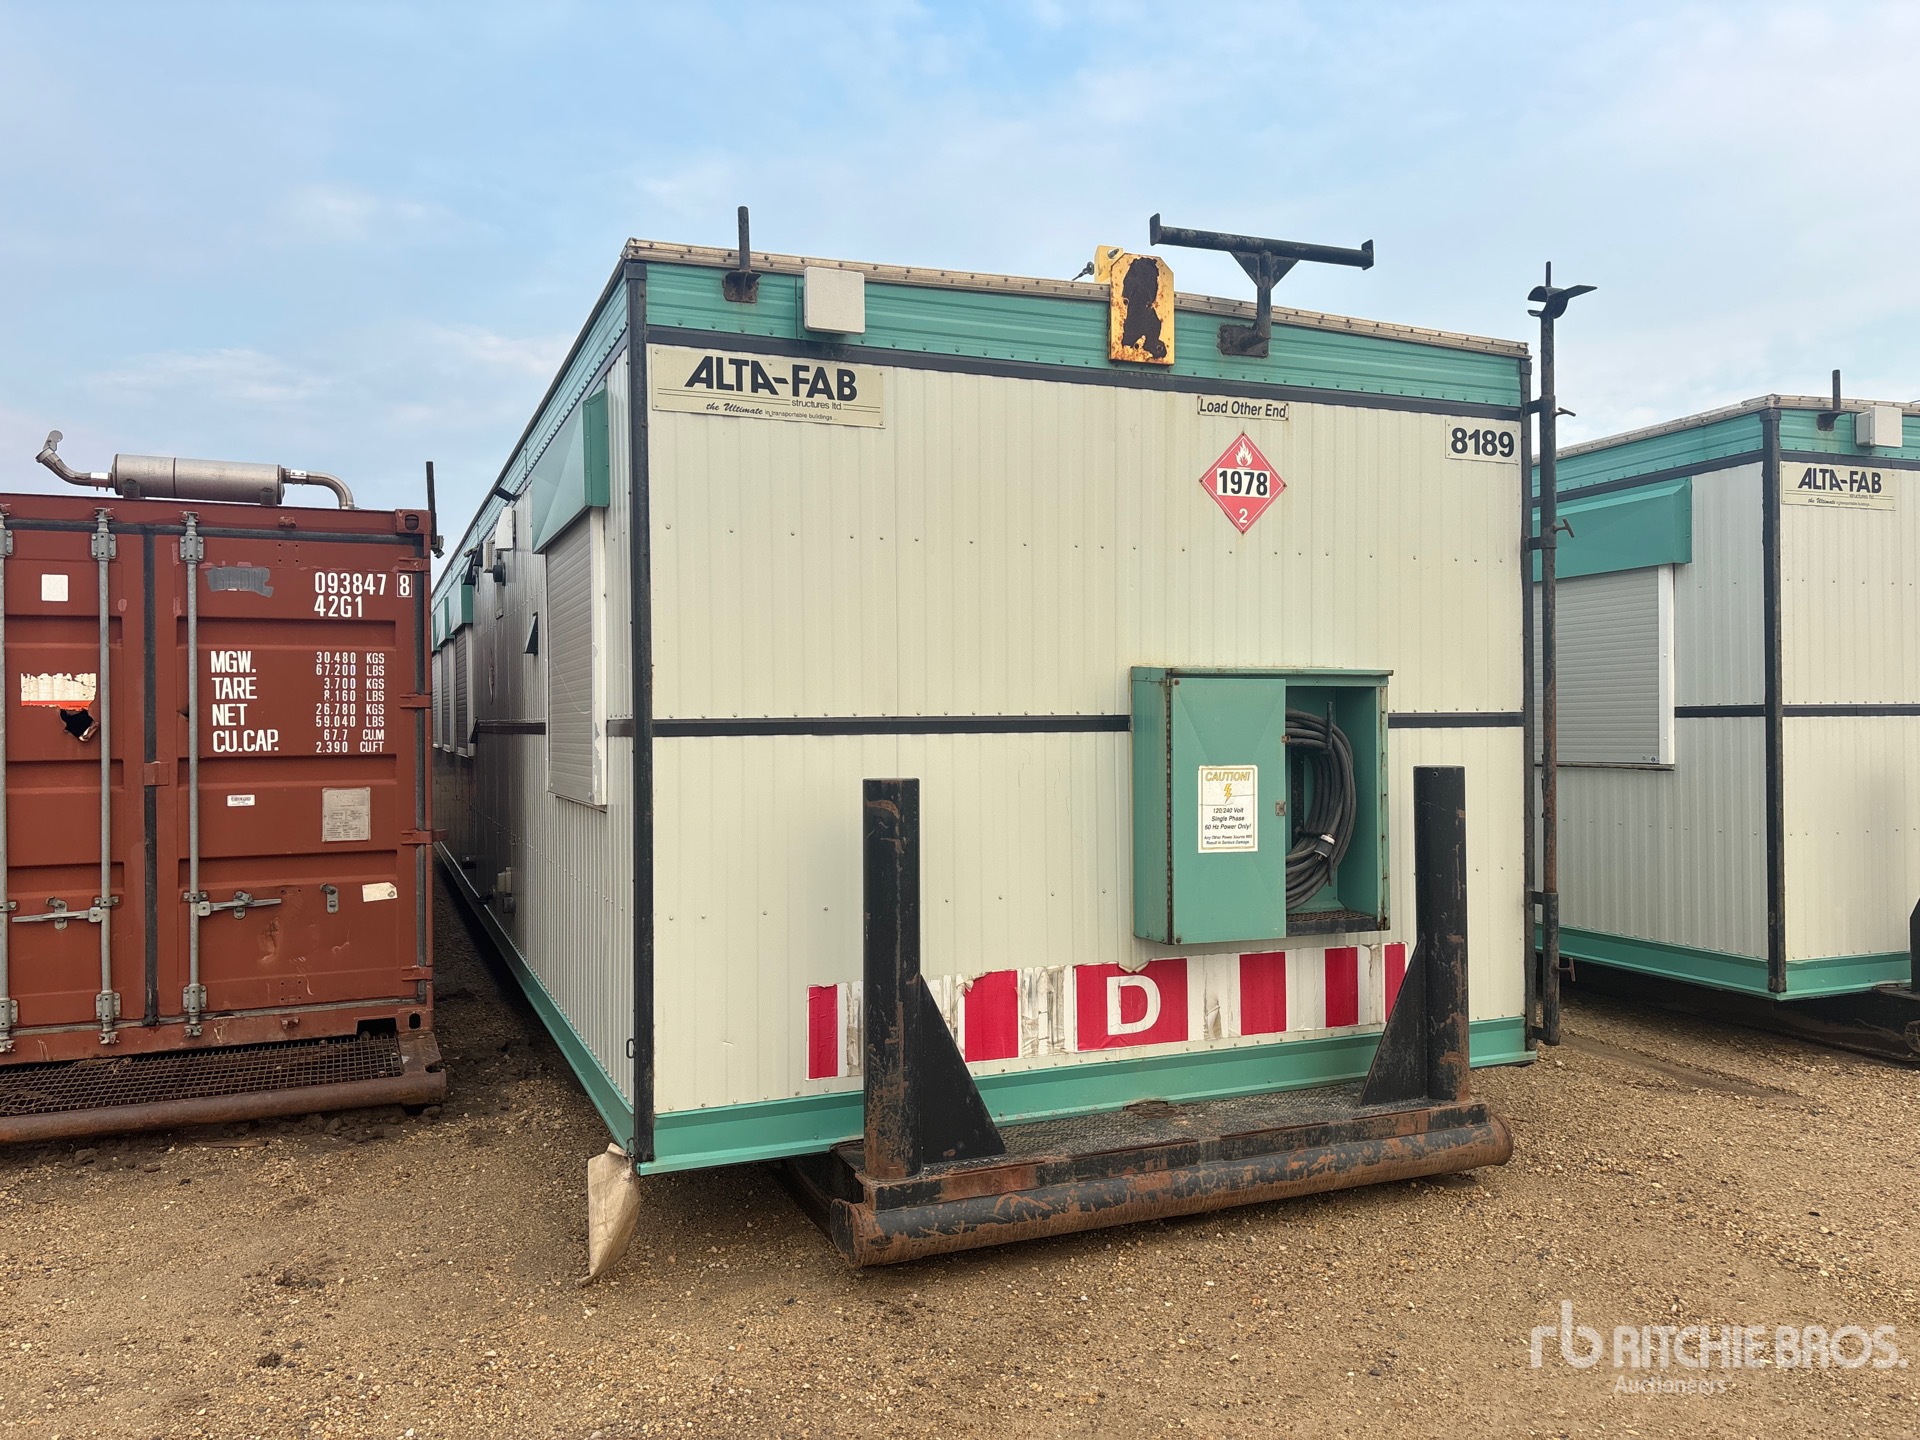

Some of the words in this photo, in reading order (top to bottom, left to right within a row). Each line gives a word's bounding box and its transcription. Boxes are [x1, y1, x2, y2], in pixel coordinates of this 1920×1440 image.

[684, 355, 858, 402] ALTA-FAB
[705, 402, 720, 411] the
[723, 402, 763, 415] Ultimate
[808, 413, 833, 421] buildings
[791, 400, 829, 409] structures
[1200, 398, 1228, 414] Load
[1231, 400, 1262, 416] Other
[1265, 403, 1287, 418] End
[1450, 427, 1515, 458] 8189
[1218, 470, 1269, 497] 1978
[1797, 467, 1882, 494] ALTA-FAB
[1238, 508, 1249, 524] 2
[314, 571, 387, 596] 093847
[399, 575, 410, 596] 8
[313, 594, 363, 618] 42G1
[210, 650, 257, 673] MGW.
[316, 651, 356, 664] 30.480
[366, 652, 385, 664] KGS
[315, 664, 356, 676] 67.200
[366, 665, 385, 677] LBS
[211, 676, 258, 700] TARE
[323, 677, 356, 690] 3.700
[366, 678, 385, 690] KGS
[323, 690, 356, 702] 8.160
[366, 690, 385, 702] LBS
[212, 703, 248, 726] NET
[315, 703, 356, 715] 26.780
[366, 703, 385, 715] KGS
[315, 715, 356, 728] 59.040
[366, 715, 385, 728] LBS
[212, 729, 279, 753] CU.CAP.
[323, 729, 348, 741] 67.7
[362, 729, 385, 741] CU.M
[315, 741, 348, 753] 2.390
[359, 741, 385, 753] CU.FT
[1205, 771, 1251, 782] CAUTION!
[1106, 975, 1161, 1036] D
